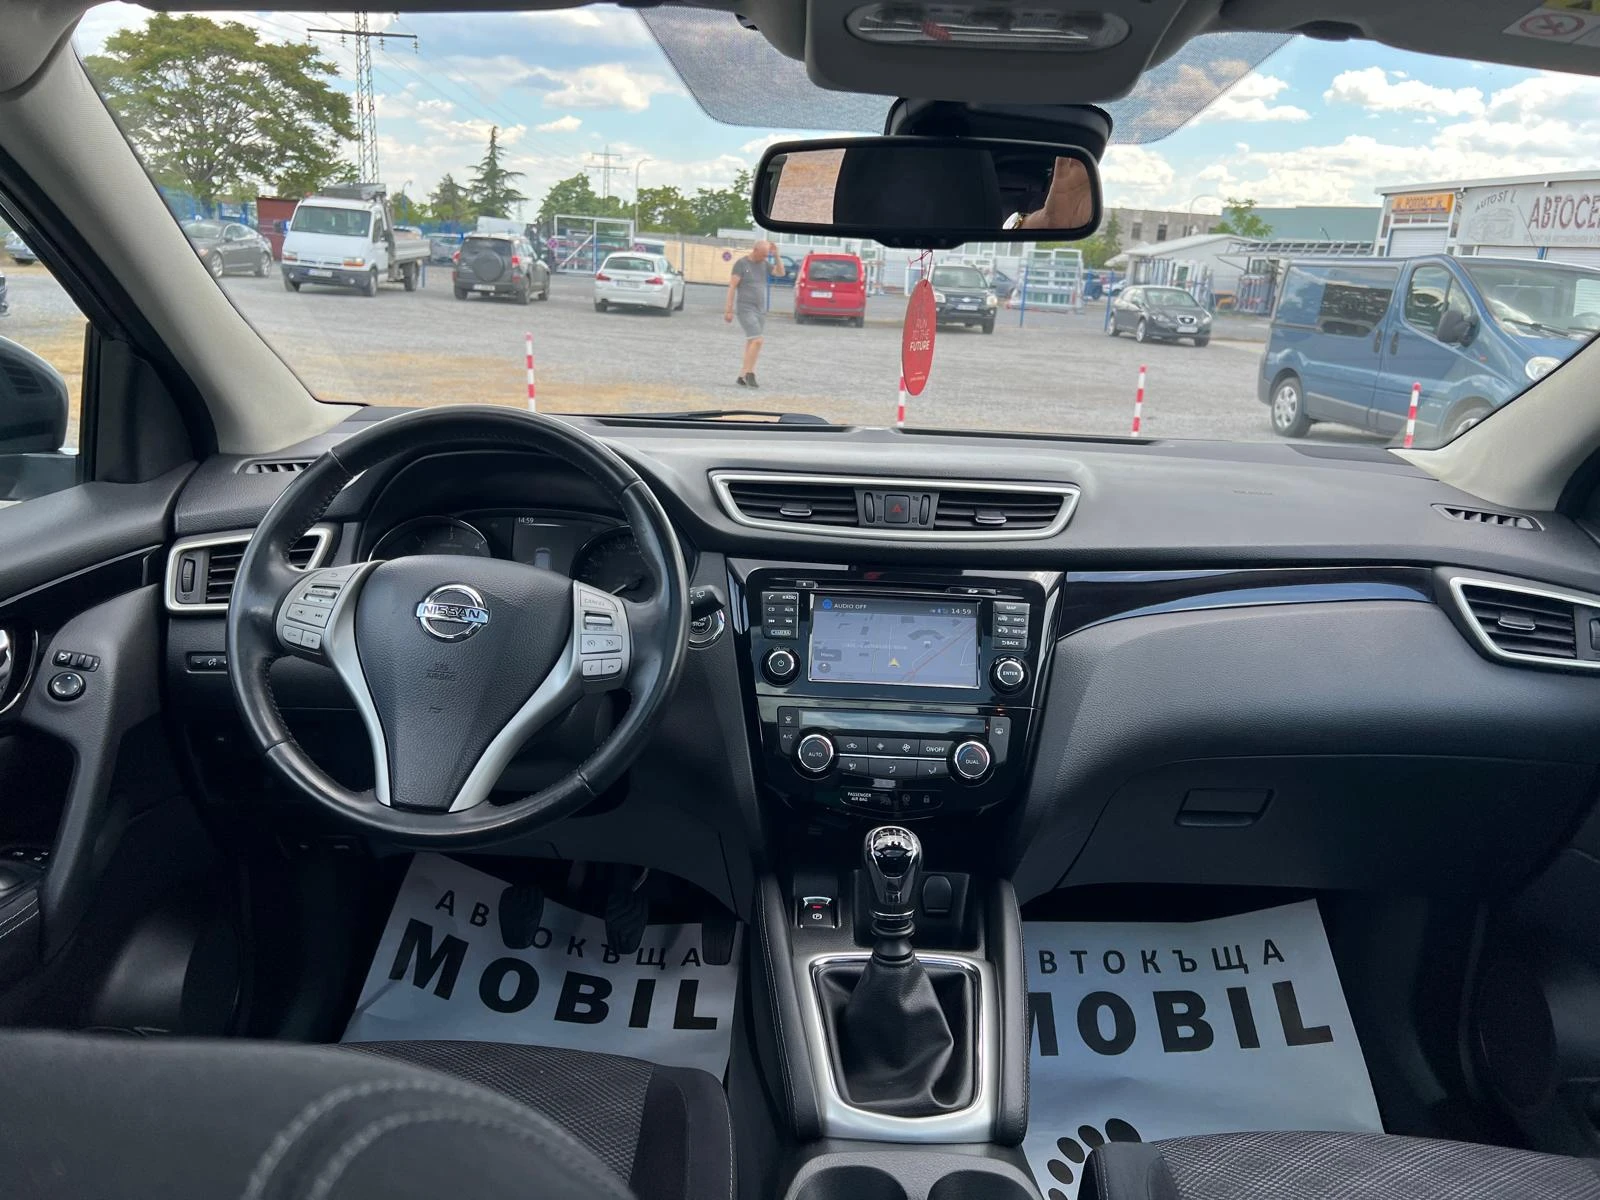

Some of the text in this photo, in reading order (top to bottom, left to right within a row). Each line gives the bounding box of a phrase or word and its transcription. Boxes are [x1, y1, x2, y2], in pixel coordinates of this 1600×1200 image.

[1528, 193, 1600, 229] АВТОСЕ
[909, 340, 930, 351] FUTURE
[423, 605, 480, 619] NISSAN
[435, 890, 702, 970] АВОКЪЩА
[388, 918, 718, 1030] MOBIL
[1038, 938, 1285, 974] ВТОКЪЩА
